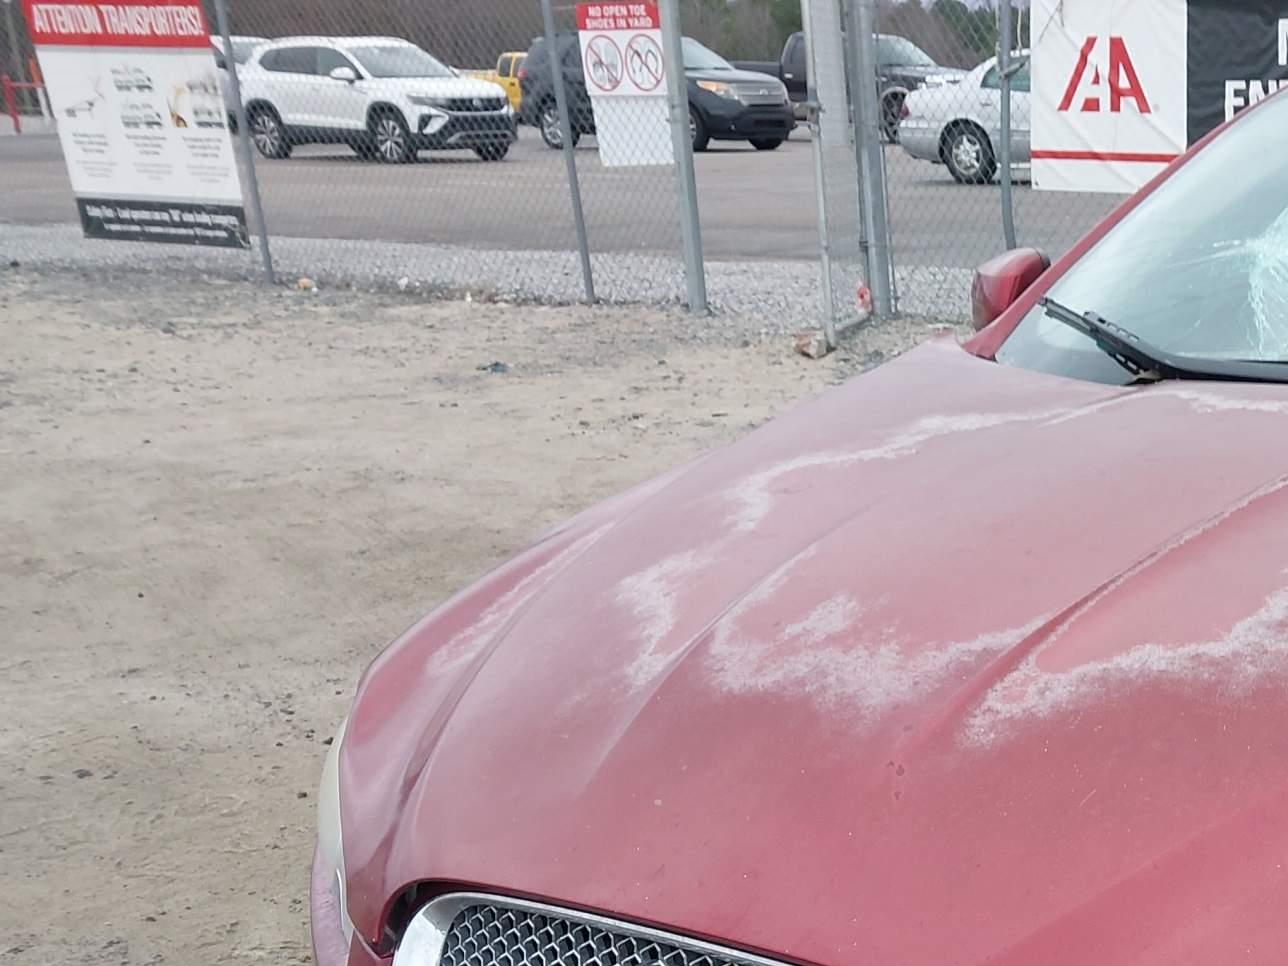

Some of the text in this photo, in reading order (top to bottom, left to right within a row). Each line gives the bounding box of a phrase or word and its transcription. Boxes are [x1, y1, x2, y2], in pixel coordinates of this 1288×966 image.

[588, 4, 646, 17] NO OPEN TOE
[32, 4, 205, 36] ATTENTION TRANSPORTERS!
[585, 16, 653, 29] SHOES IN YARD
